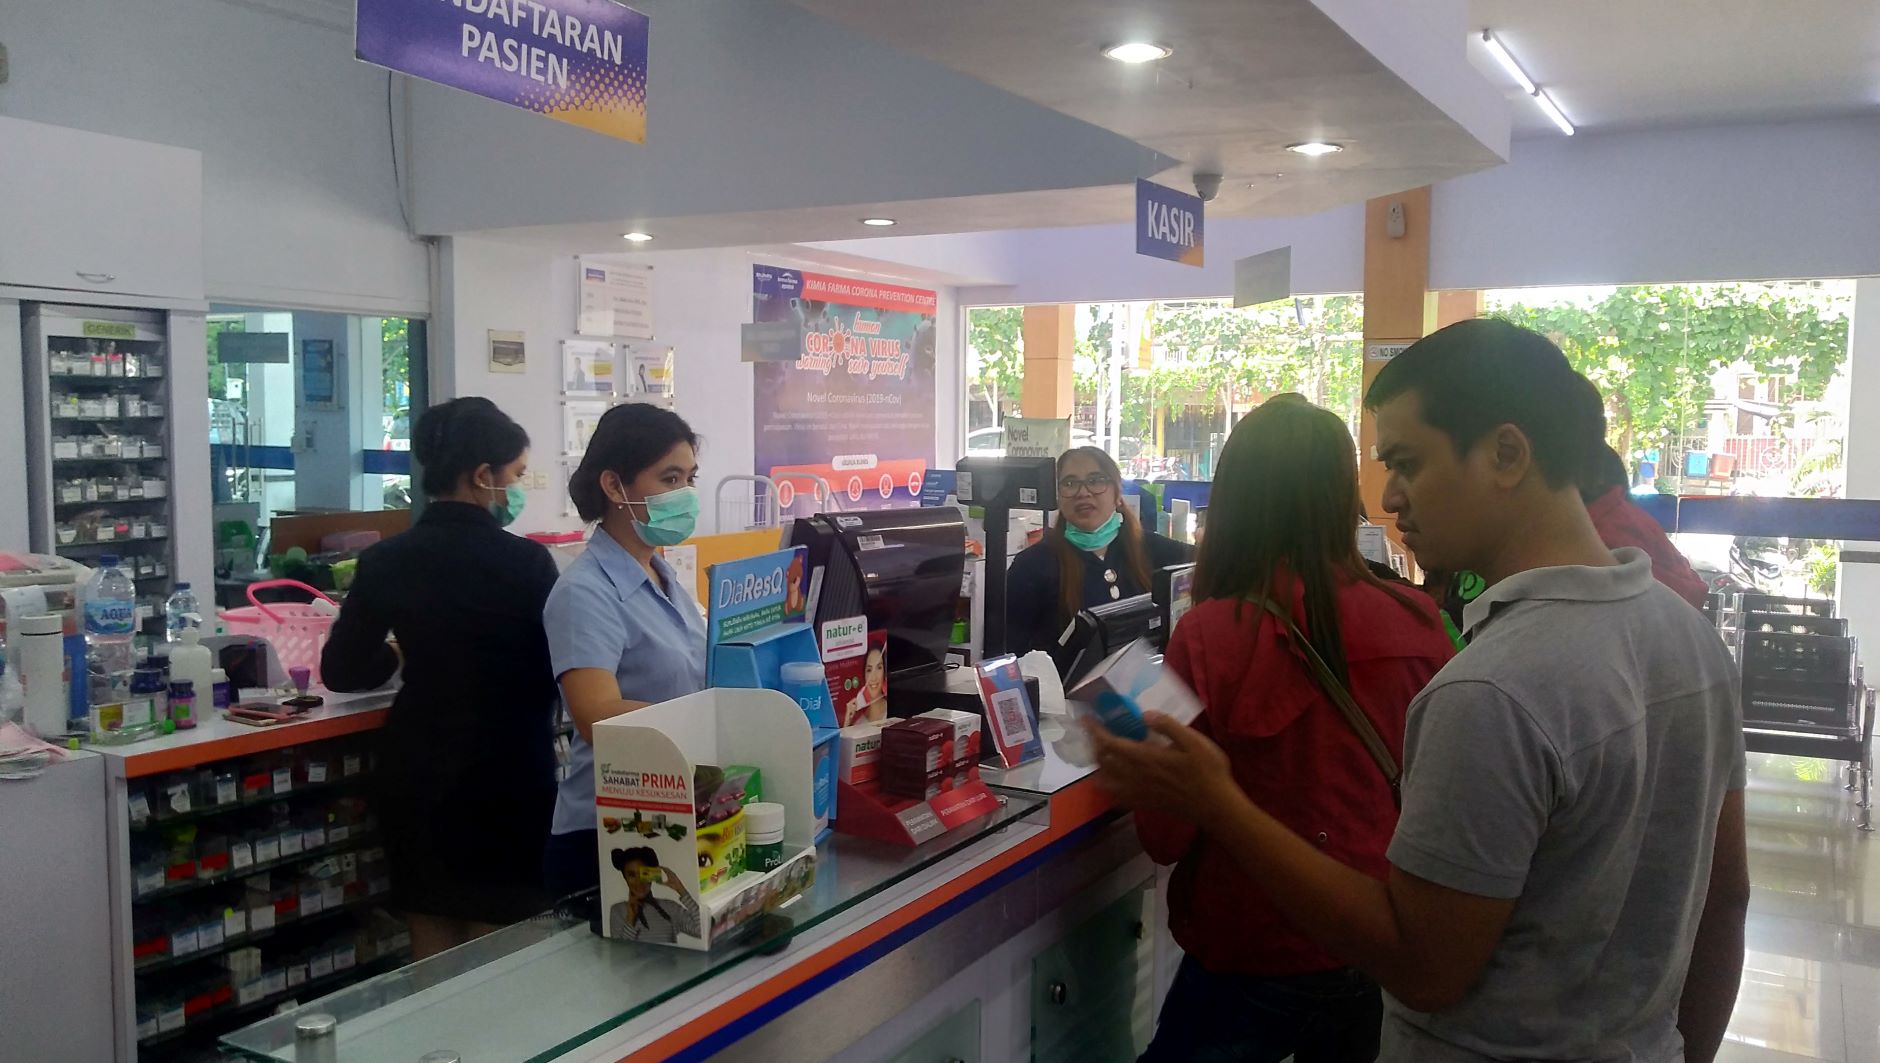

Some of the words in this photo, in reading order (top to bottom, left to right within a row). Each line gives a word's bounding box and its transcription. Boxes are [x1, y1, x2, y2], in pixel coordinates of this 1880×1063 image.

[441, 0, 623, 64] AFTARAN
[461, 23, 568, 90] PASIEN
[1148, 199, 1195, 248] KASIR
[806, 279, 827, 291] KIMIA
[827, 282, 851, 294] FARMA
[868, 336, 901, 359] VIRUS
[1007, 425, 1029, 442] Novel
[603, 776, 640, 787] SAHABAT
[642, 772, 686, 791] PRIMA
